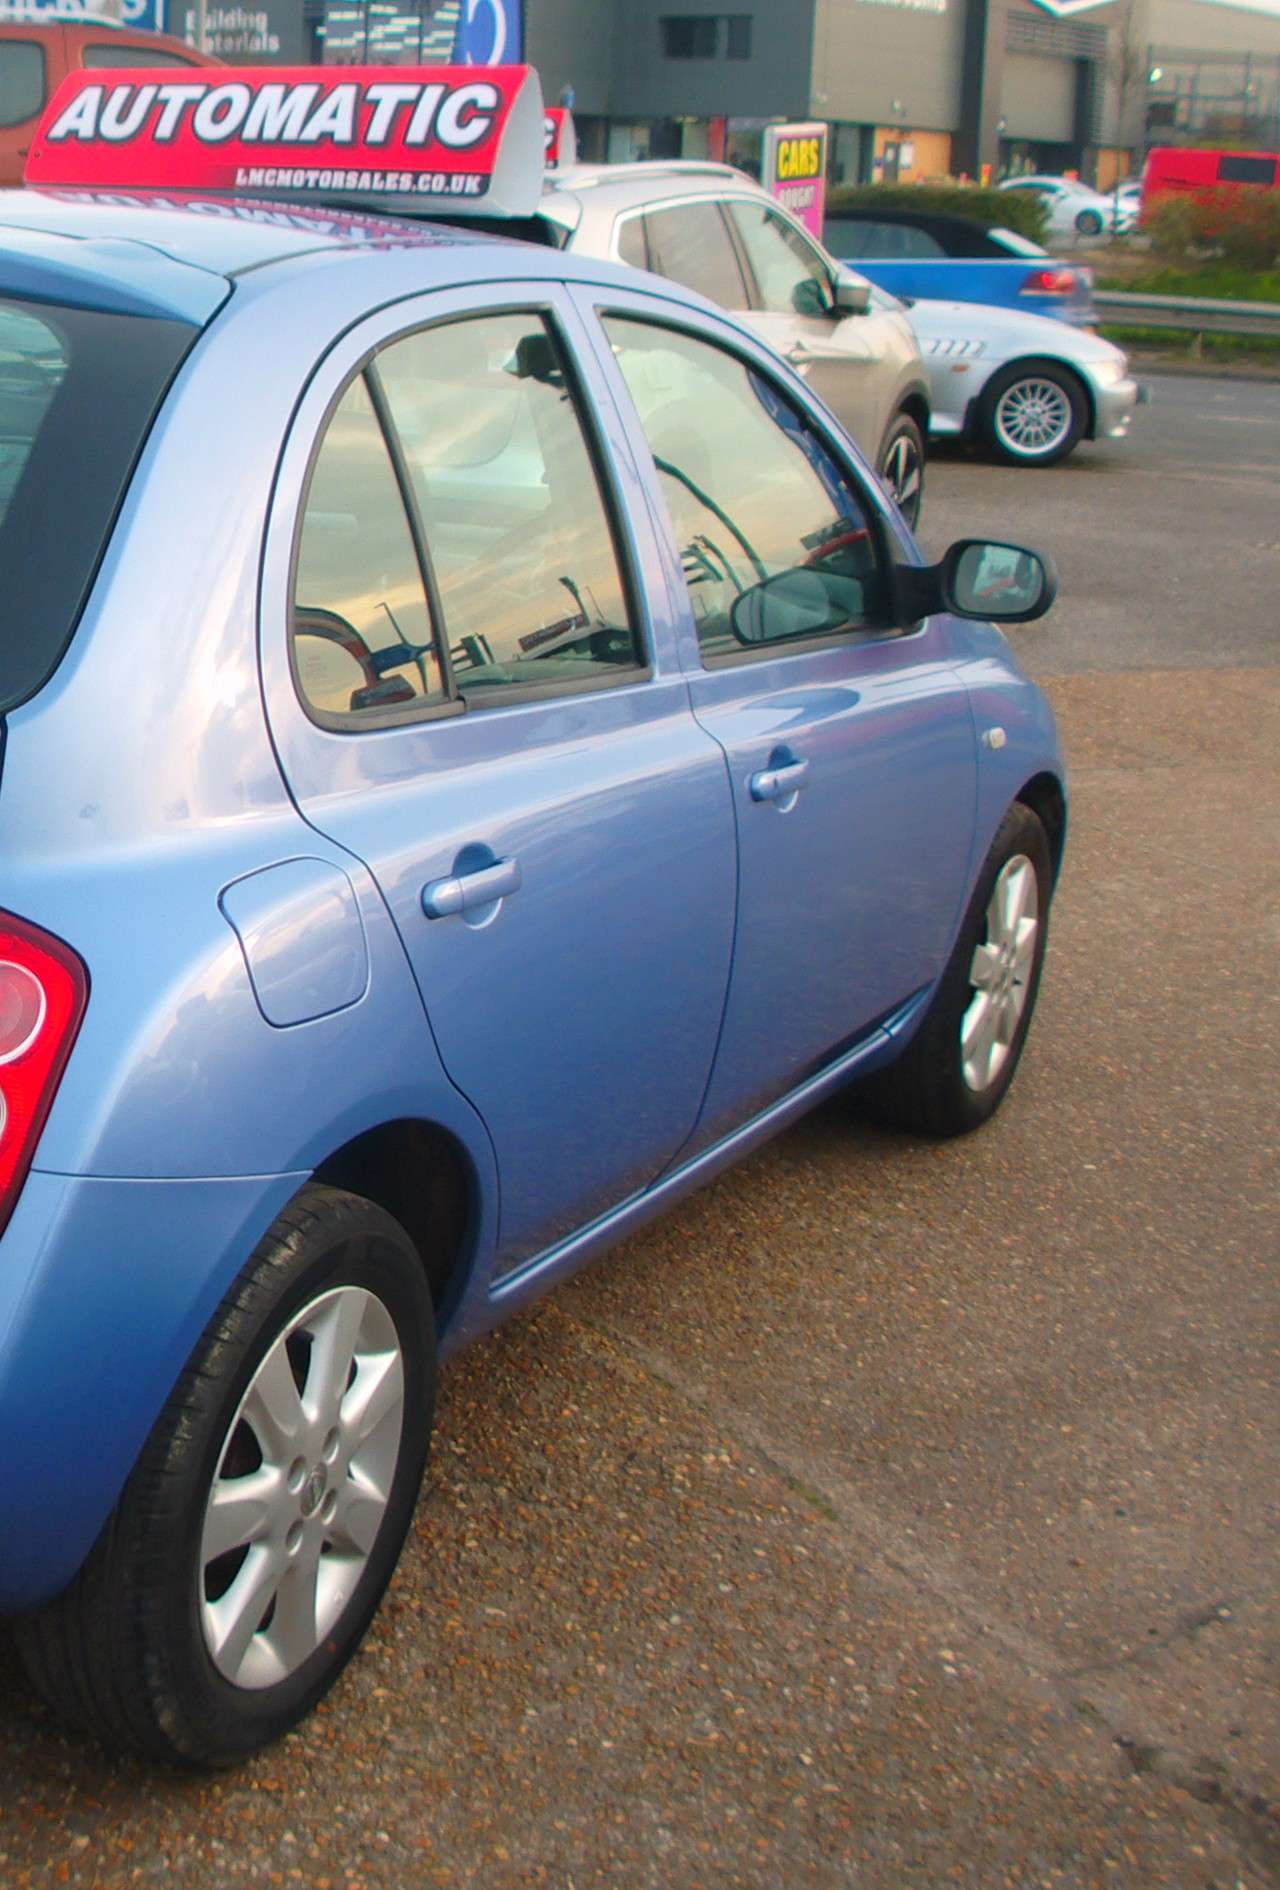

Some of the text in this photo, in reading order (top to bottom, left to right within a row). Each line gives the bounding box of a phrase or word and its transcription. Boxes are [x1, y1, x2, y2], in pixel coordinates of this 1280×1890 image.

[47, 83, 498, 145] AUTOMATIC
[777, 138, 819, 177] CARS
[235, 166, 482, 195] LMCMOTORSALES.CO.UK
